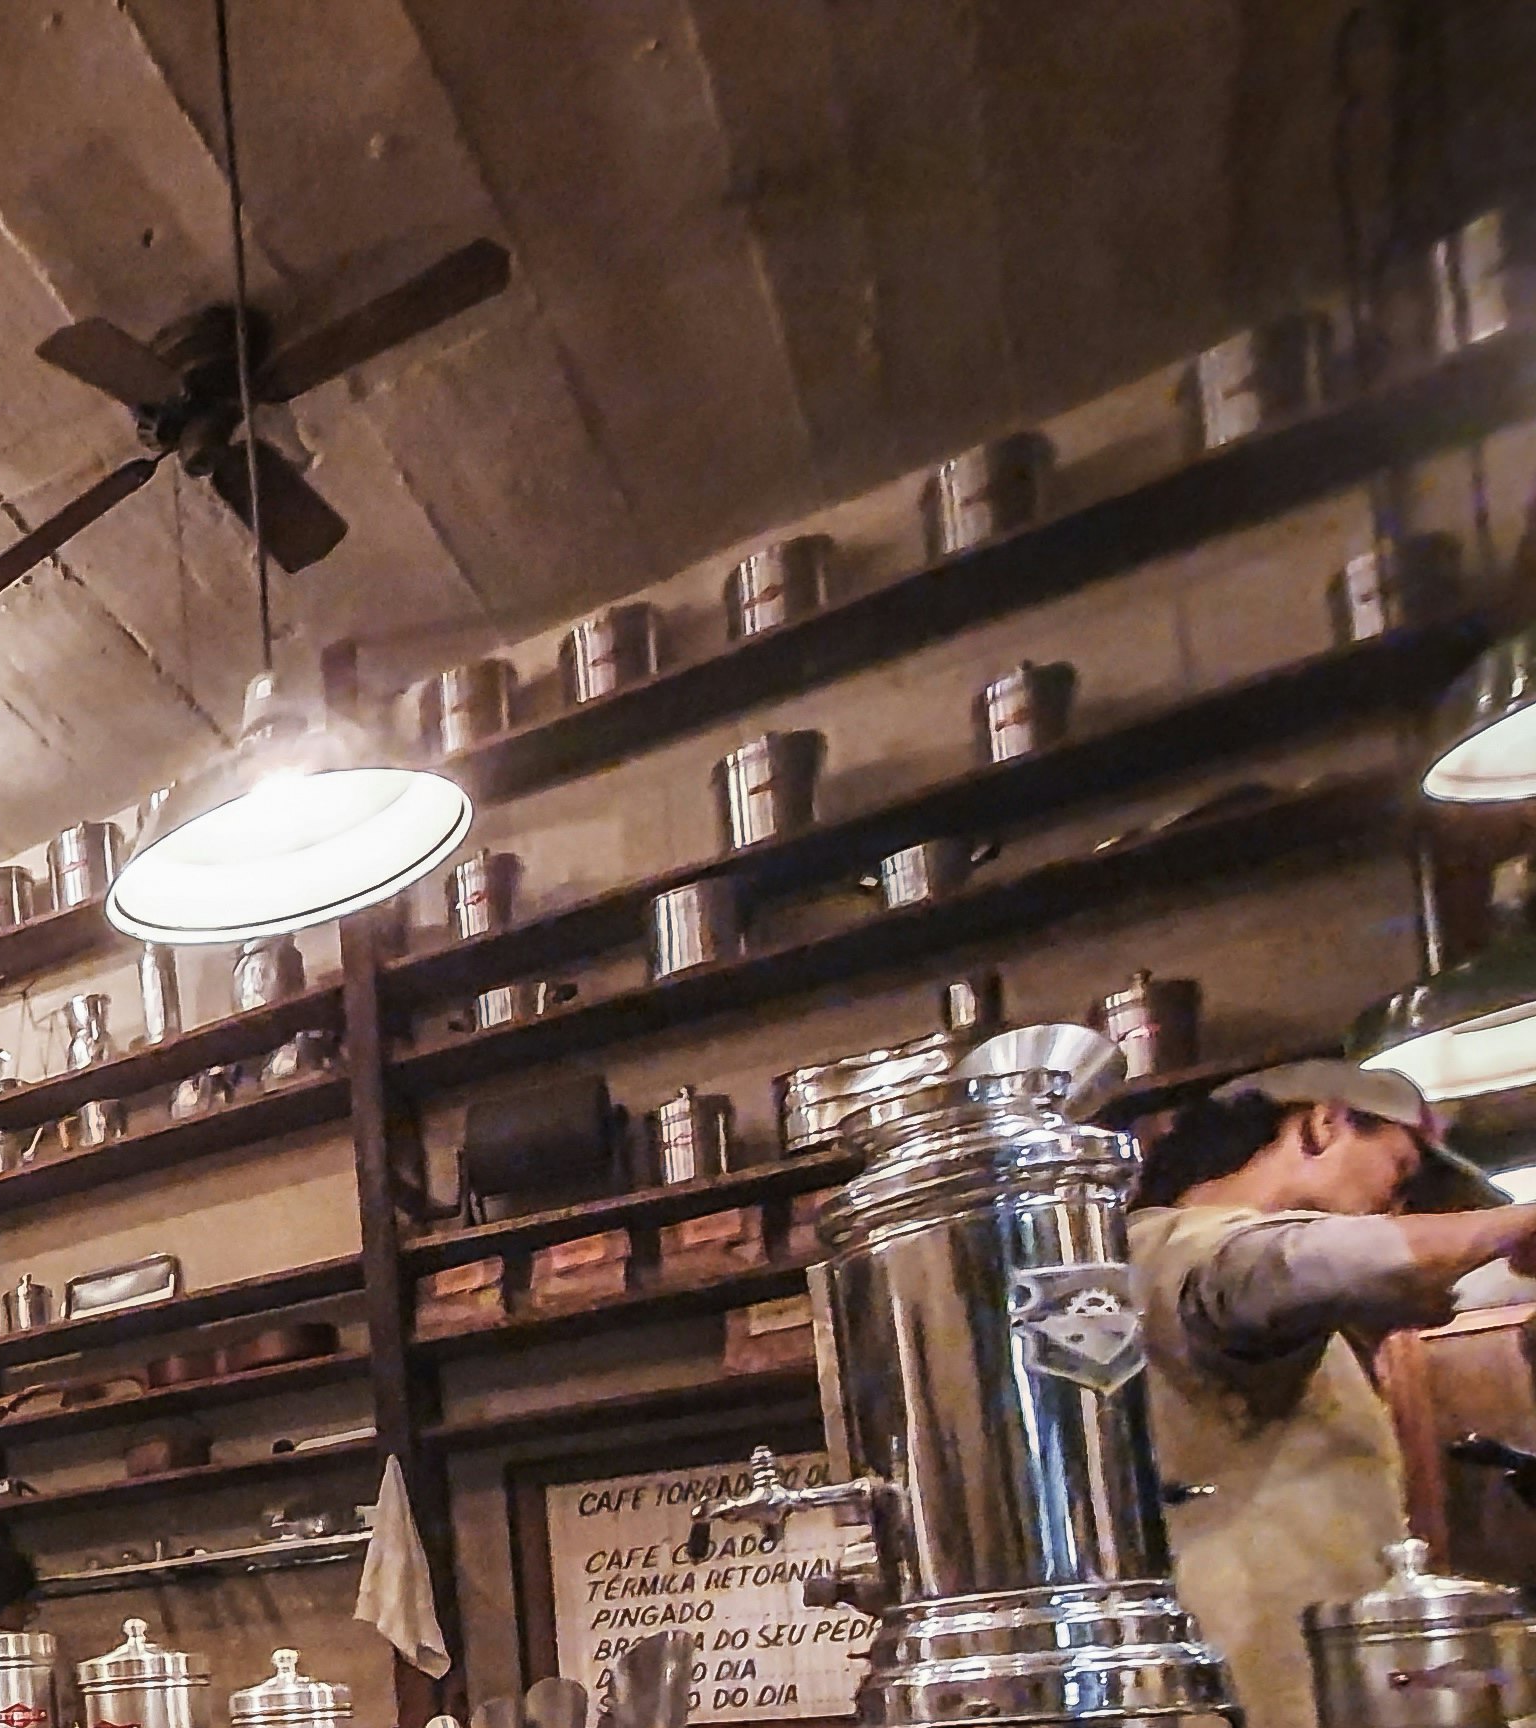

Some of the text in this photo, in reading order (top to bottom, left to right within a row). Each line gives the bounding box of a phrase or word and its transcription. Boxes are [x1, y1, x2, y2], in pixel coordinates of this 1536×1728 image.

[655, 1471, 751, 1507] TORRAD
[590, 1599, 715, 1630] PINGADO
[713, 1628, 749, 1652] DO
[755, 1623, 807, 1649] SEU
[714, 1658, 757, 1682] DIA
[712, 1687, 749, 1710] DO
[755, 1683, 798, 1707] DIA
